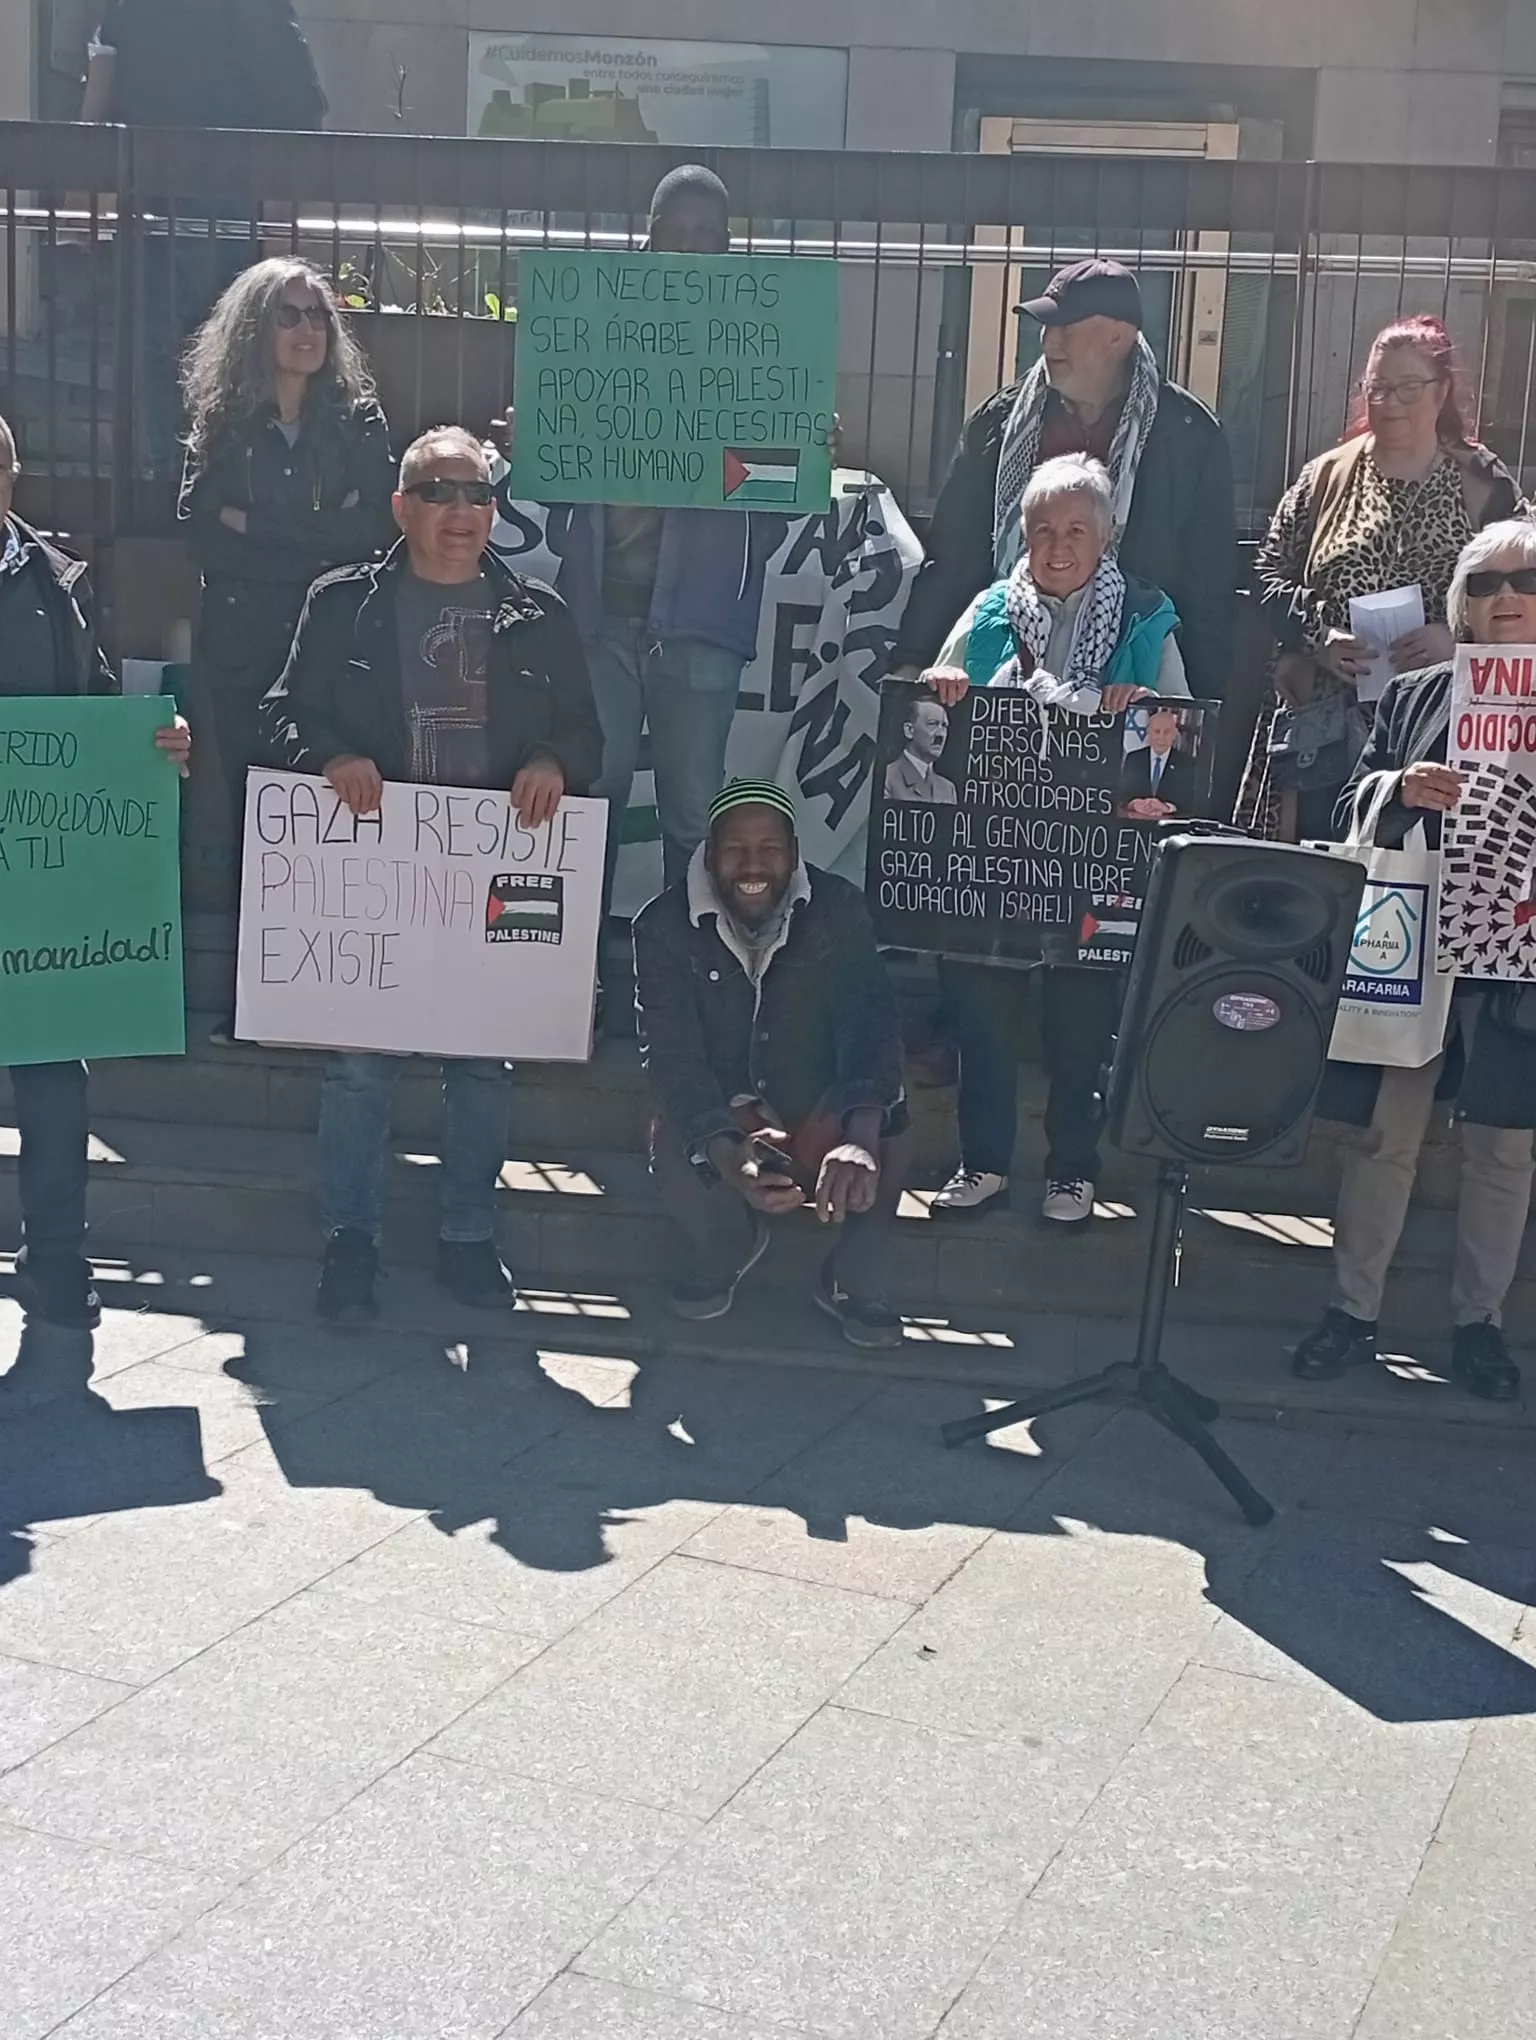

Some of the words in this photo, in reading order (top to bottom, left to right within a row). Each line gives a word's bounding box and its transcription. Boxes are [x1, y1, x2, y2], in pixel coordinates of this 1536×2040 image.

[531, 266, 581, 303] NO
[596, 267, 781, 308] NECESITAS
[530, 316, 590, 353] SER
[605, 313, 695, 356] ÁRABE
[708, 319, 781, 357] PARA
[537, 367, 650, 404] APOYAR
[668, 368, 687, 404] A
[699, 366, 824, 402] PALESTI-
[536, 404, 585, 439] NA,
[596, 405, 663, 442] SOLO
[676, 409, 828, 446] NECESITAS
[538, 444, 593, 482] SER
[603, 447, 704, 482] HUMANO
[1469, 657, 1536, 697] INA
[969, 725, 1107, 764] PERSONAS,
[967, 753, 1054, 783] MISMAS
[963, 779, 1112, 815] ATROCIDADES
[257, 782, 383, 845] GAZA
[415, 790, 584, 872] RESISTE
[882, 808, 936, 844] ALTO
[953, 811, 977, 849] AL
[986, 814, 1108, 858] GENOCIDIO
[1116, 828, 1152, 864] EN
[16, 836, 64, 869] TU
[880, 850, 942, 883] GAZA,
[947, 853, 1063, 888] PALESTINA
[1073, 861, 1134, 894] LIBRE
[260, 850, 475, 930] PALESTINA
[496, 875, 554, 889] FREE
[880, 880, 986, 918] OCUPACIÓN
[999, 890, 1073, 924] ISRAELI
[486, 928, 561, 944] PALESTINE
[1077, 948, 1132, 963] PALEST
[1360, 938, 1399, 950] PHARMA
[260, 926, 400, 990] EXISTE
